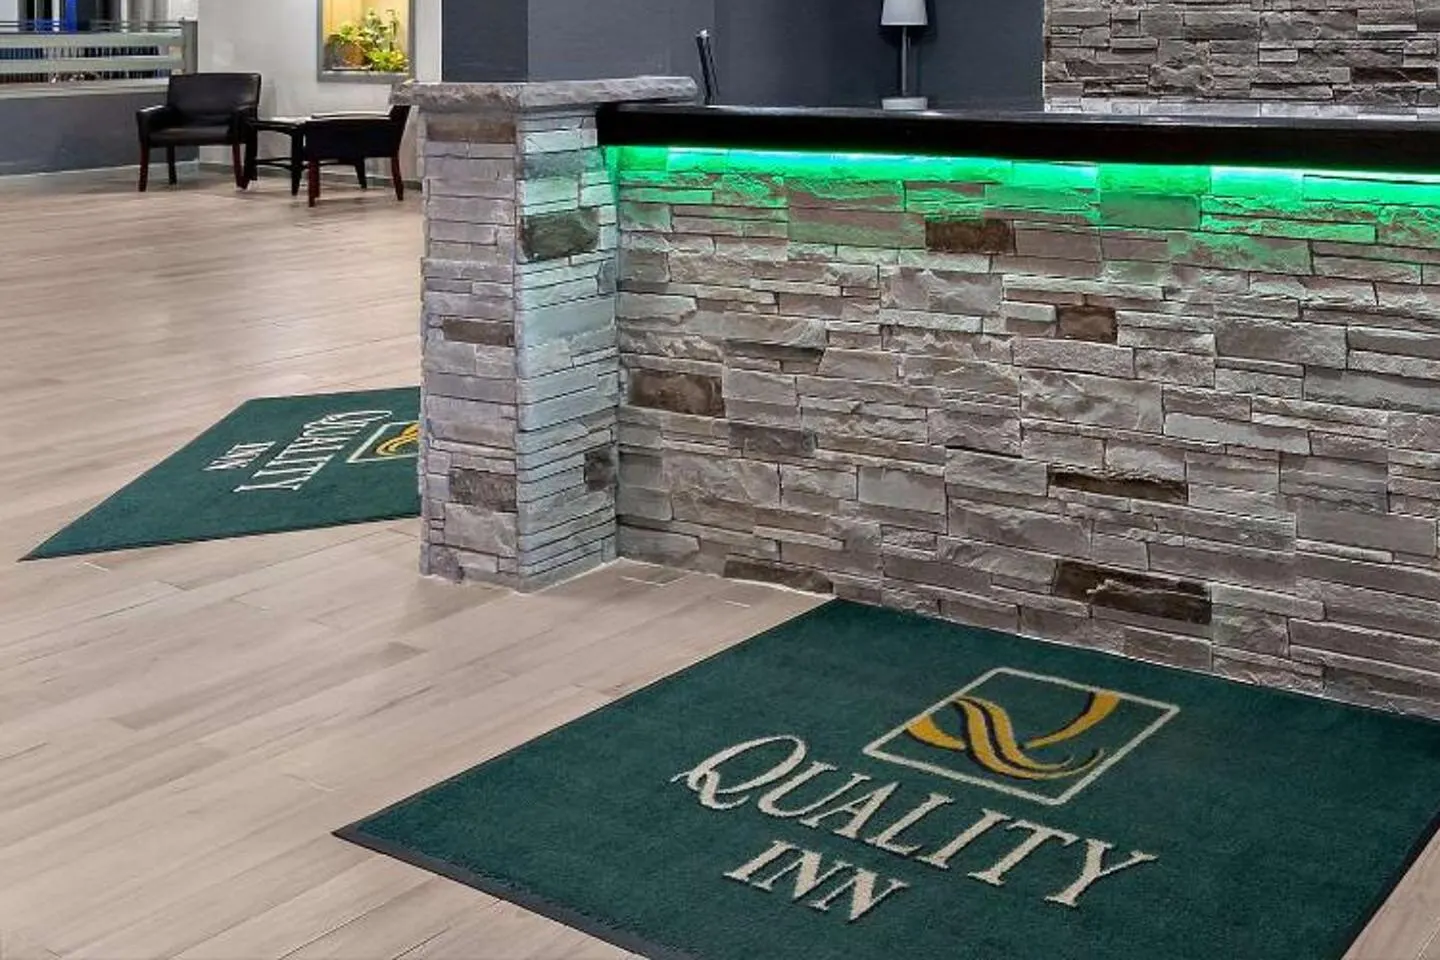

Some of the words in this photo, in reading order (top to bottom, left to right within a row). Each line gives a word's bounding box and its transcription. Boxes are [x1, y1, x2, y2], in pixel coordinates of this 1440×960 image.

[233, 410, 393, 493] QUALITY
[671, 734, 1159, 908] QUALITY
[723, 839, 909, 921] INN
